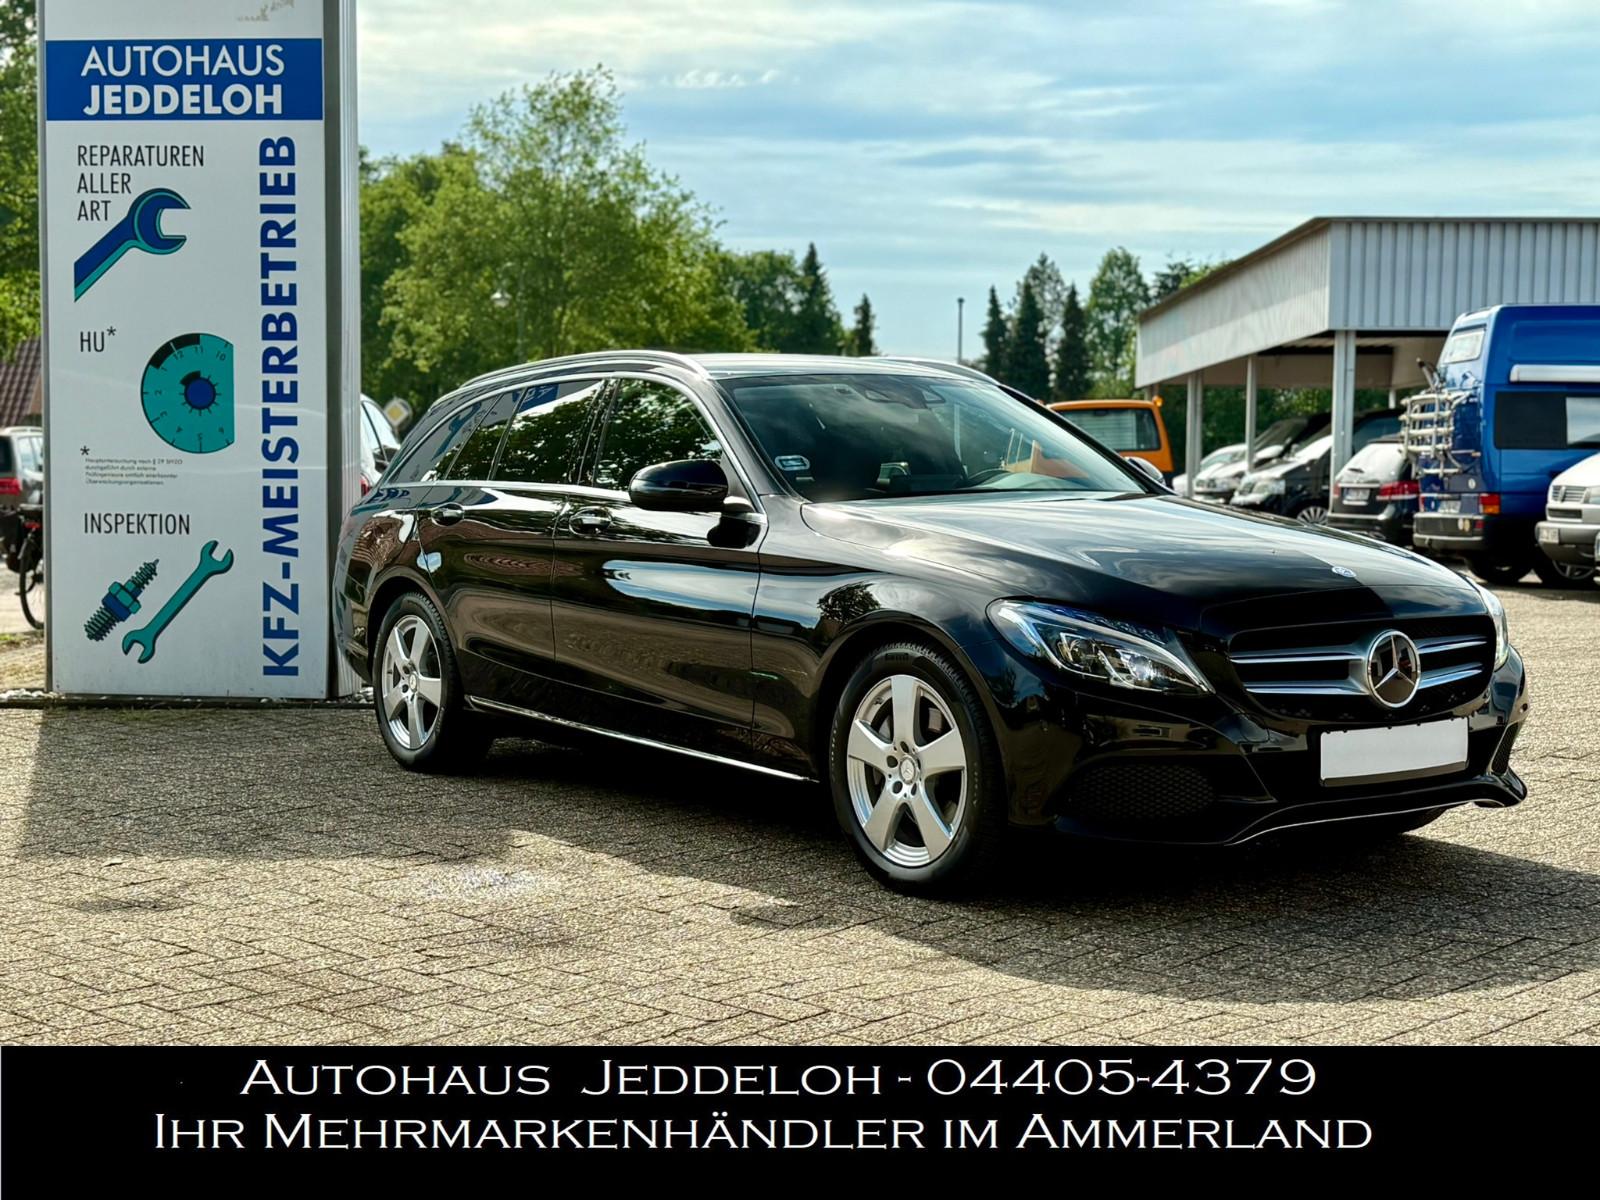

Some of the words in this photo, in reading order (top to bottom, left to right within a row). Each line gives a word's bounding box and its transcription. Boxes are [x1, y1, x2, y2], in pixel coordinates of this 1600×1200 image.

[81, 45, 285, 76] AUTOHAUS
[83, 84, 283, 115] JEDDELOH
[77, 145, 204, 166] REPARATUREN
[77, 173, 132, 194] ALLER
[77, 200, 112, 221] ART
[216, 351, 226, 361] 10
[259, 136, 300, 677] KFZ-MEISTERBETRIEB
[84, 513, 190, 535] INSPEKTION
